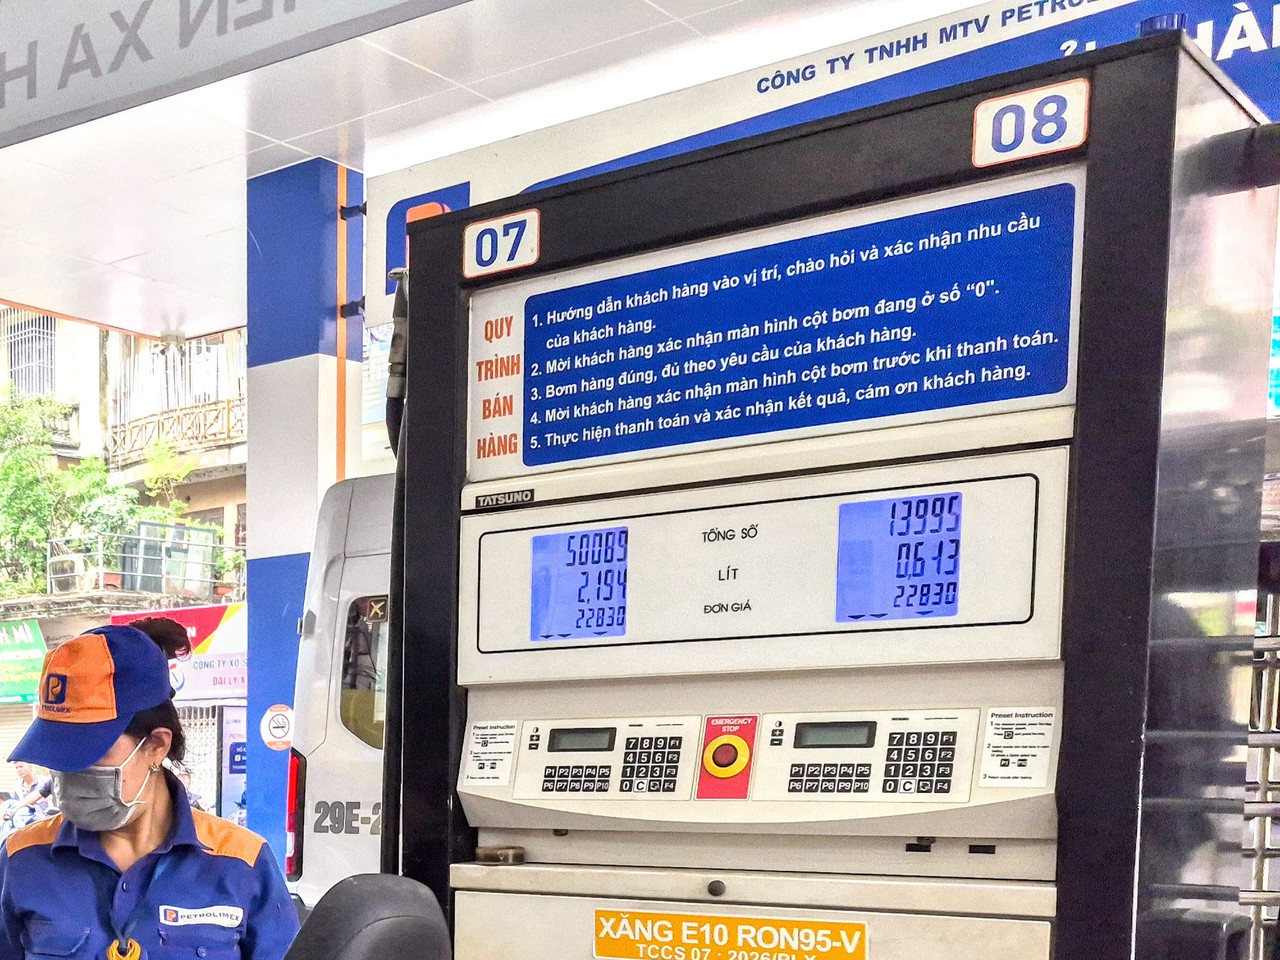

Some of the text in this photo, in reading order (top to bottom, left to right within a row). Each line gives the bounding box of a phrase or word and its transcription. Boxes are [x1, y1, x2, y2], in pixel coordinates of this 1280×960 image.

[756, 62, 816, 94] CÔNG
[826, 55, 855, 75] TY
[865, 34, 928, 67] TNHH
[938, 15, 990, 45] MTV
[990, 93, 1069, 154] 08
[475, 219, 528, 267] 07
[532, 214, 1040, 328] 1. Hướng dẫn khách hàng vào vị trí, chào hỏi và xác nhận nhu cầu
[484, 316, 514, 343] QUY
[531, 363, 542, 377] 2.
[546, 356, 571, 374] Mời
[574, 349, 615, 369] khách
[619, 344, 653, 361] hàng
[656, 337, 682, 354] xác
[686, 330, 723, 349] nhận
[727, 323, 759, 341] màn
[764, 315, 798, 335] hình
[802, 310, 828, 329] cột
[832, 305, 870, 323] bơm
[874, 297, 917, 315] đang
[921, 290, 935, 307] ở
[939, 284, 961, 304] số
[546, 319, 656, 349] của khách hàng.
[476, 352, 521, 382] TRÌNH
[530, 329, 1059, 425] 4. Mời khách hàng xác nhận màn hình cột bơm trước khi thanh toán.
[531, 326, 916, 401] 3. Bơm hàng đúng, đủ theo yêu cầu của khách hàng.
[482, 392, 514, 420] BÁN
[530, 364, 1031, 449] 5. Thực hiện thanh toán và xác nhận kết quả, cám ơn khách hàng.
[476, 431, 519, 459] HÀNG
[478, 490, 532, 507] TATSUNO
[889, 495, 960, 537] 13995
[702, 523, 759, 543] TỔNG SỐ
[718, 565, 739, 582] LÍT
[703, 599, 752, 614] ĐƠN GIÁ
[893, 581, 958, 608] 22830
[575, 605, 627, 629] 22830
[218, 659, 225, 668] TY
[711, 718, 753, 726] EMERGENCY
[892, 735, 900, 744] 7
[909, 734, 918, 744] 8
[926, 734, 935, 744] 9
[180, 912, 240, 922] PETROLIMEX
[599, 913, 861, 953] XĂNG E10 RON95-V
